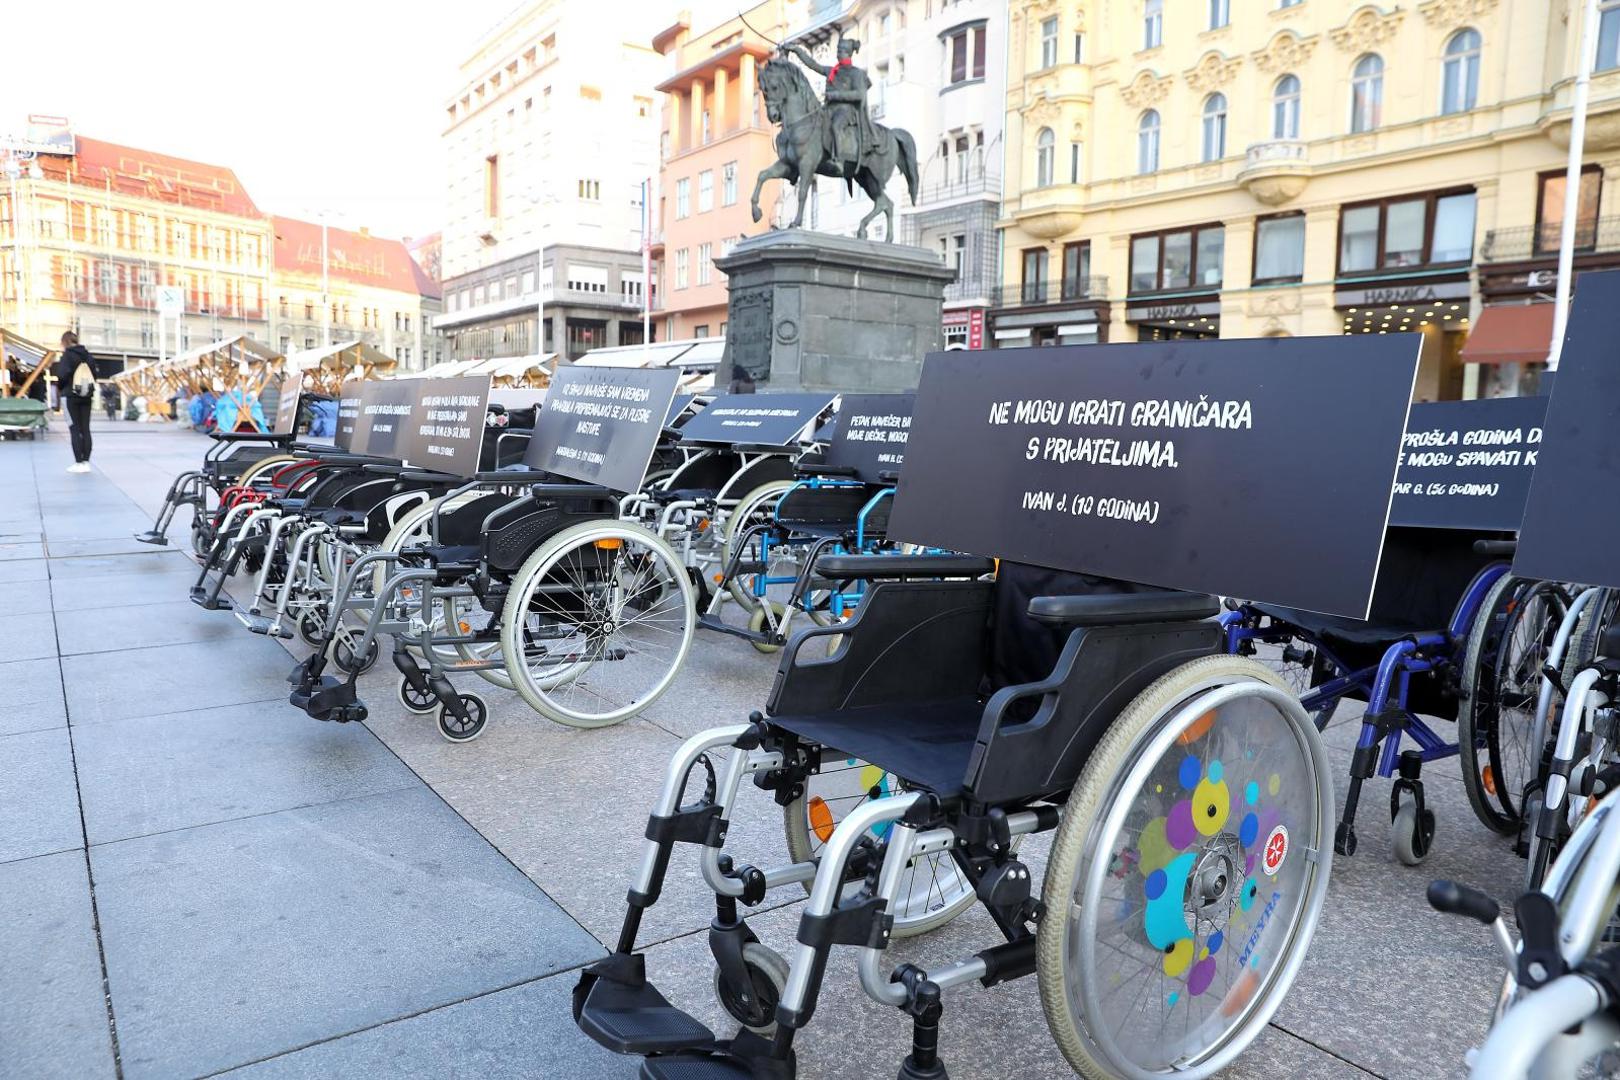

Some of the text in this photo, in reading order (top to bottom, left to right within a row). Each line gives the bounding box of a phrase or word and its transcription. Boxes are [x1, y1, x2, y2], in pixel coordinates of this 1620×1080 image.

[1364, 286, 1437, 303] HARMICA
[1147, 304, 1199, 319] HARMICA
[620, 386, 650, 401] VREMENA
[611, 405, 621, 418] SE
[619, 406, 629, 420] ZA
[989, 395, 1252, 429] NE MOGU IGRATI GRANIČARA
[851, 415, 871, 427] PETAK
[871, 414, 901, 428] NAVEČER
[847, 429, 865, 441] MOJE
[1463, 428, 1522, 445] GODINA
[1527, 428, 1543, 443] D
[1026, 437, 1179, 468] S PRIJATELJIMA.
[1408, 452, 1453, 467] MOGU
[1456, 450, 1522, 466] SPAVATI
[1449, 483, 1499, 496] GODINA)
[1022, 491, 1160, 524] IVAN J. (10 GODINA)
[1238, 892, 1280, 969] MEYRA
